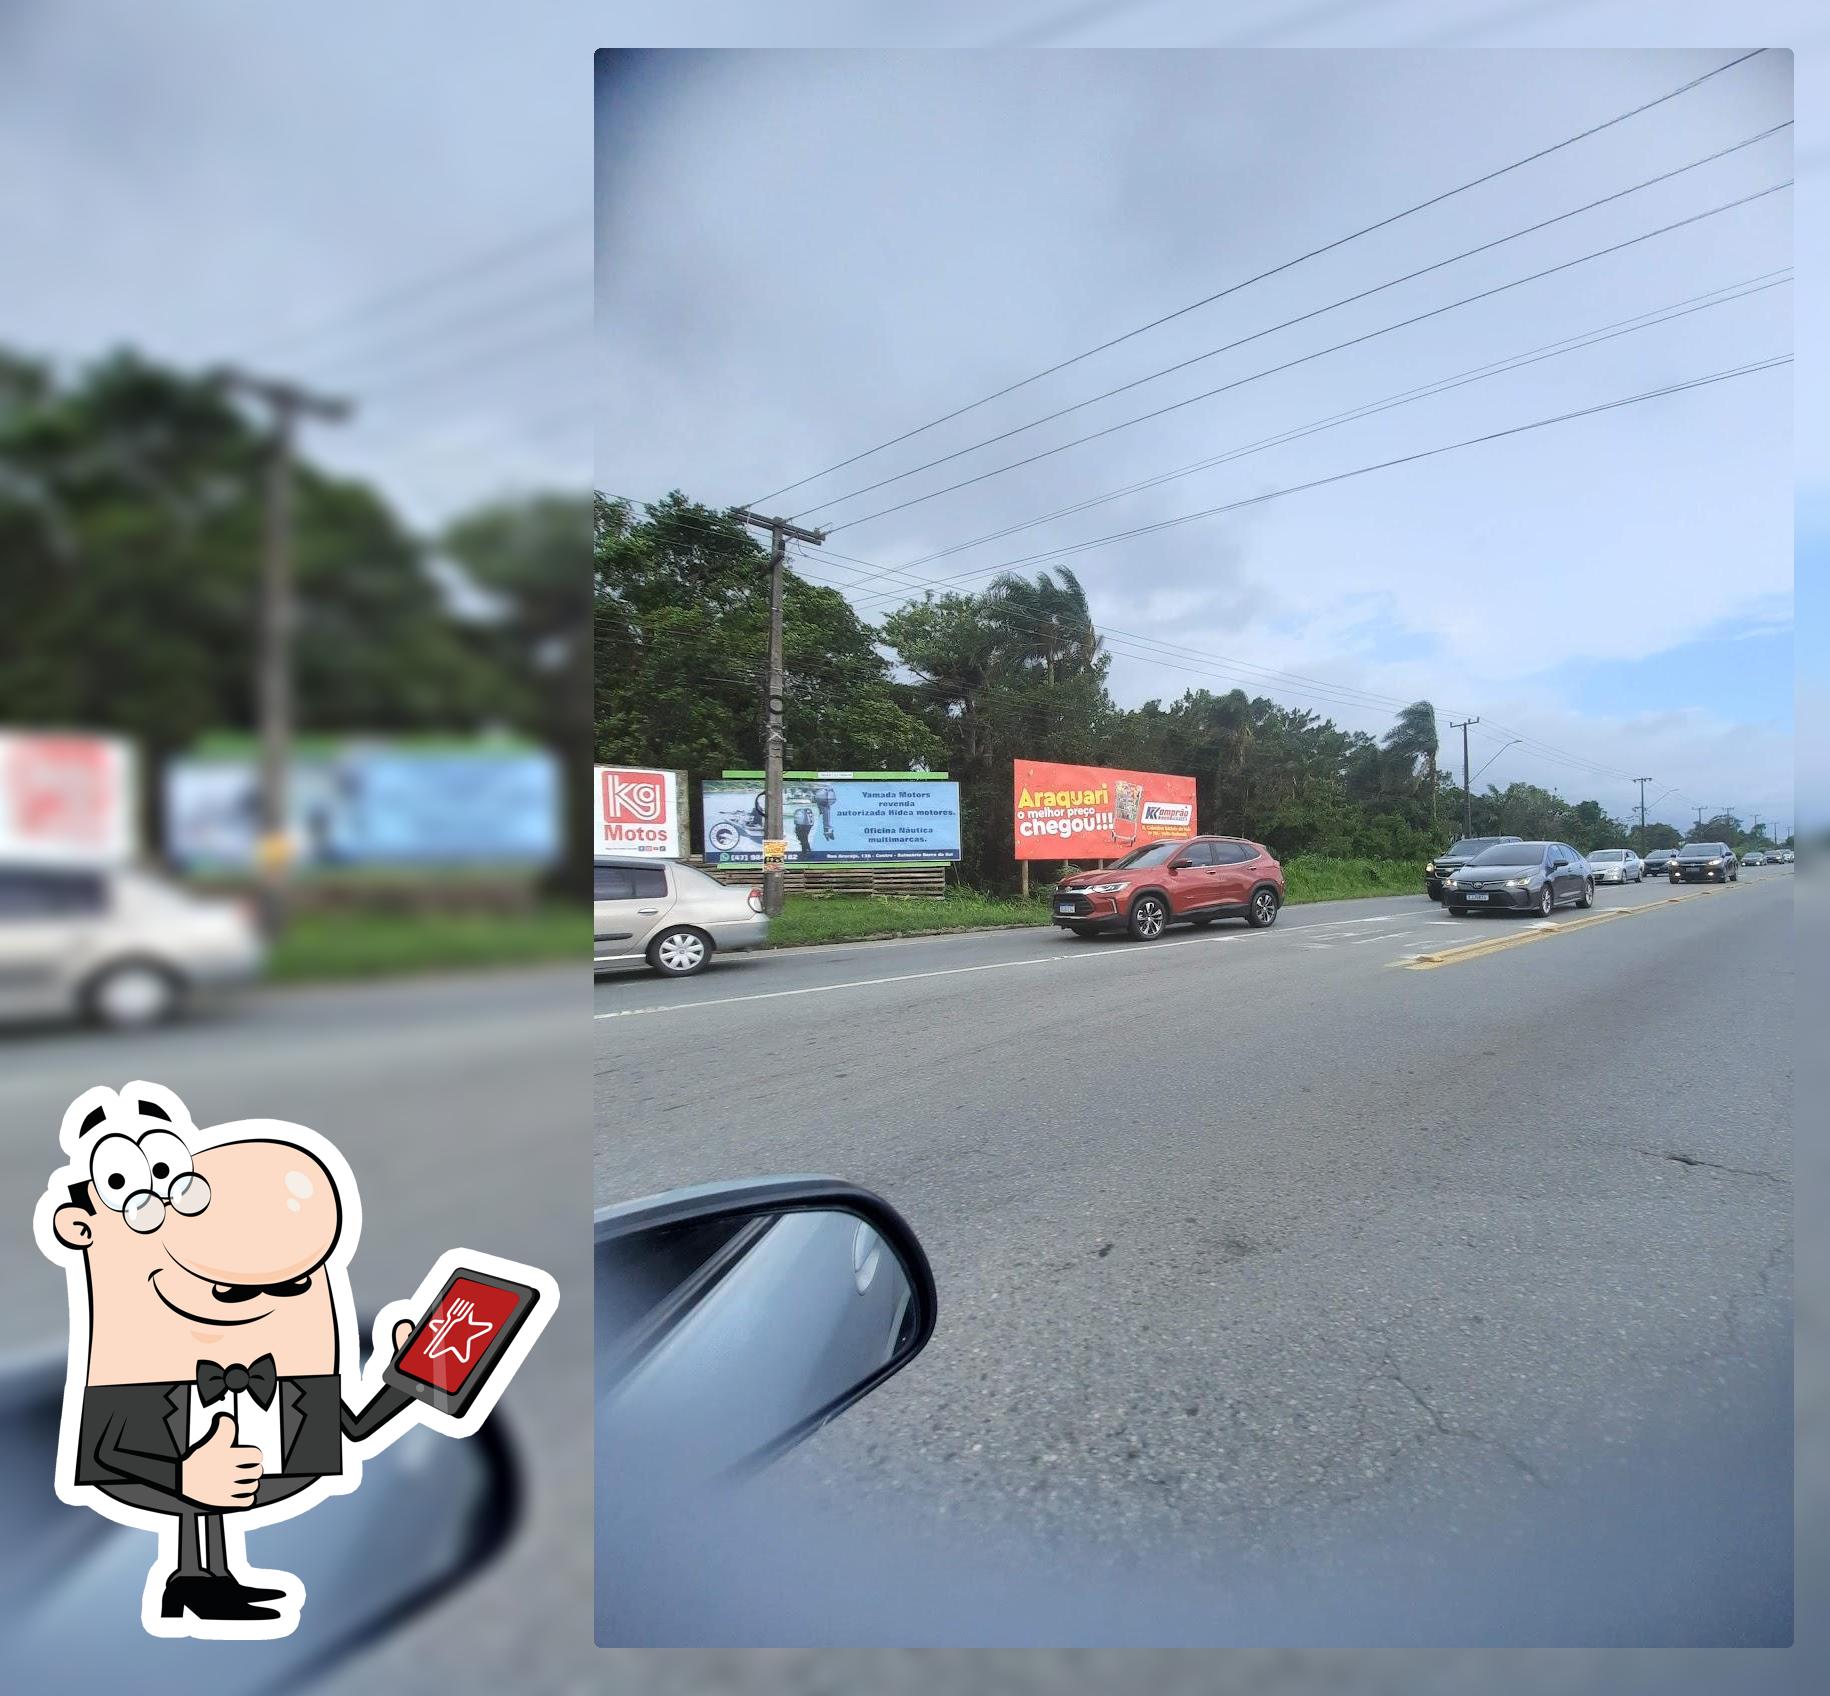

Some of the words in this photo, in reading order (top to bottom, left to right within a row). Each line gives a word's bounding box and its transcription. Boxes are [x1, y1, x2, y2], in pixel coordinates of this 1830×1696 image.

[862, 791, 896, 799] Yamada
[900, 791, 931, 799] Motors
[1018, 783, 1109, 808] Araquari
[837, 809, 886, 817] autorizada
[1017, 811, 1025, 820] o
[1027, 807, 1065, 819] melhor
[1067, 807, 1096, 818] preço
[899, 826, 933, 834] Náutica
[1019, 812, 1114, 838] chegou!!!
[603, 825, 668, 841] Motos
